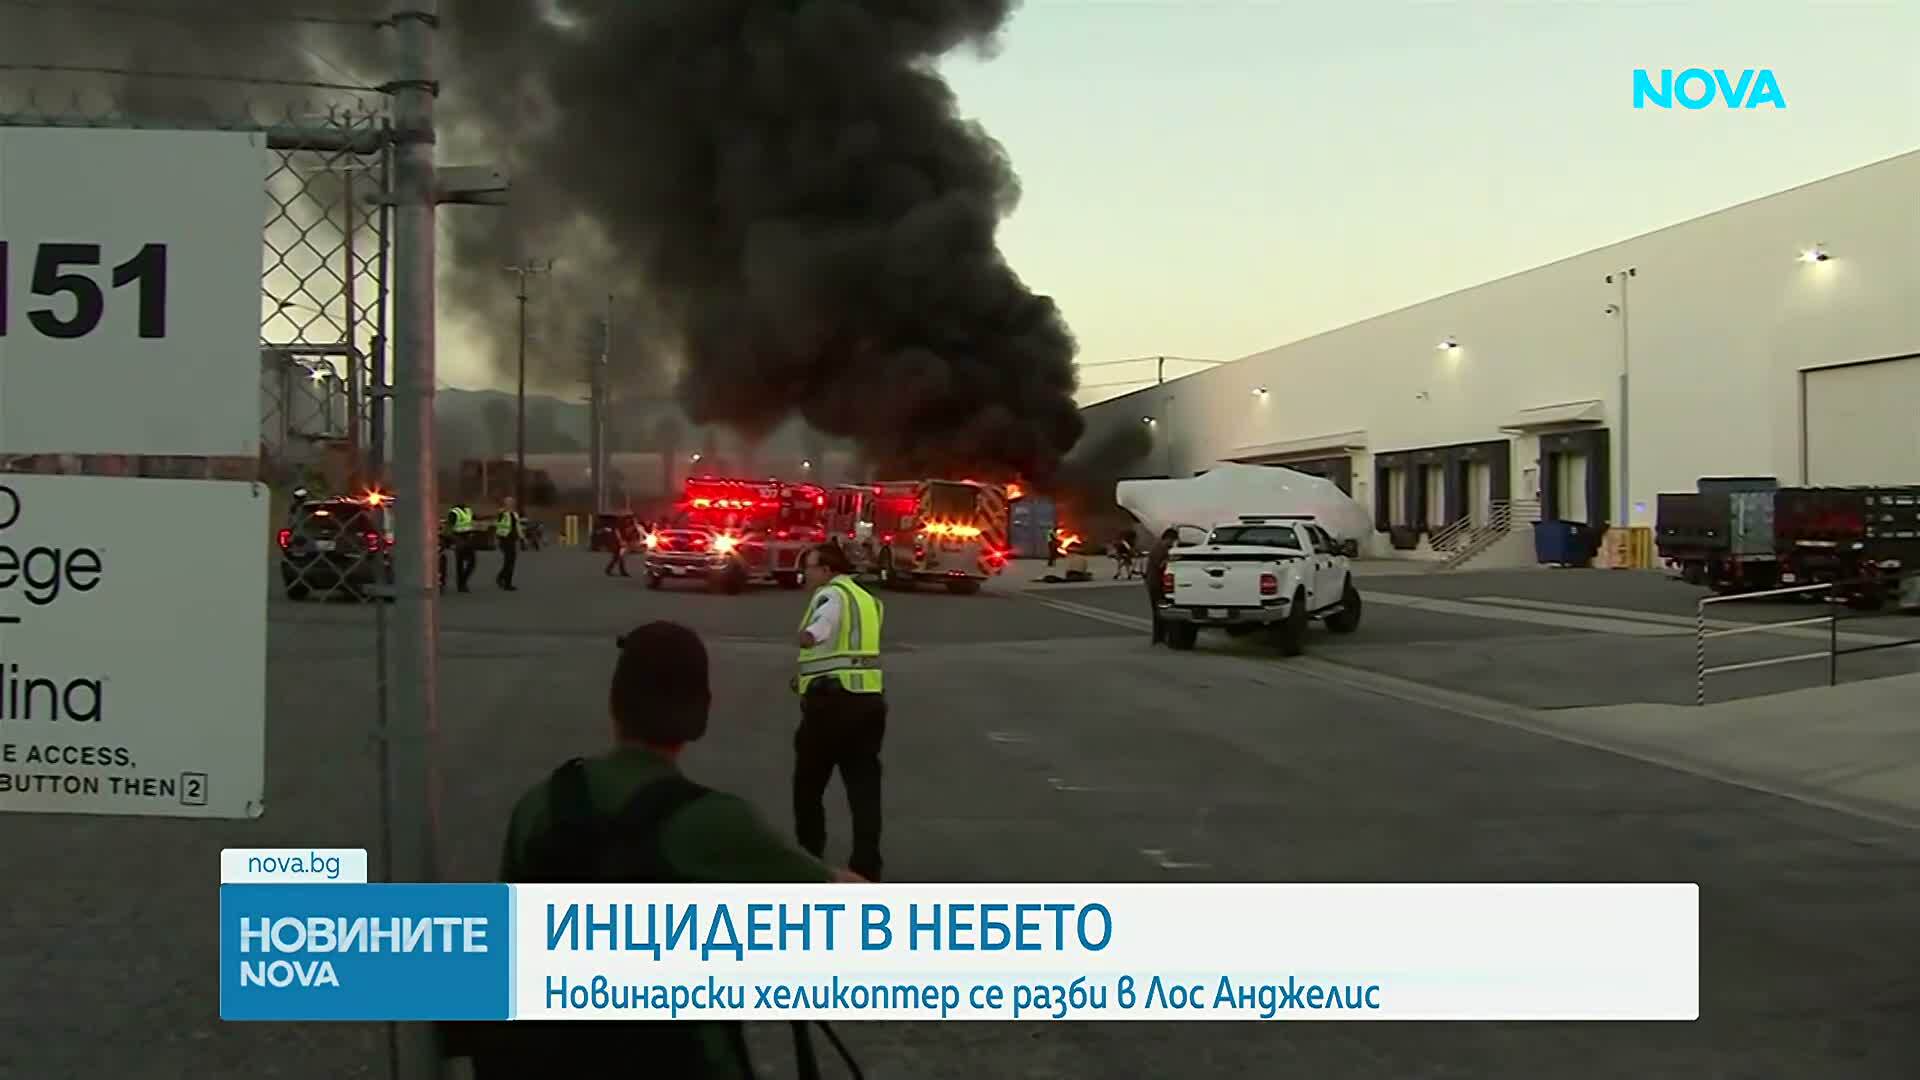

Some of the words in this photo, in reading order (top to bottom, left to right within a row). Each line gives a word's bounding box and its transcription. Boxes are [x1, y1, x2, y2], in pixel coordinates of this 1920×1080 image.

[0, 240, 168, 339] 51
[0, 545, 102, 606] ege
[3, 743, 17, 763] E
[26, 744, 137, 769] ACCESS,
[0, 773, 99, 795] BUTTON
[108, 776, 176, 798] THEN
[187, 779, 201, 798] 2
